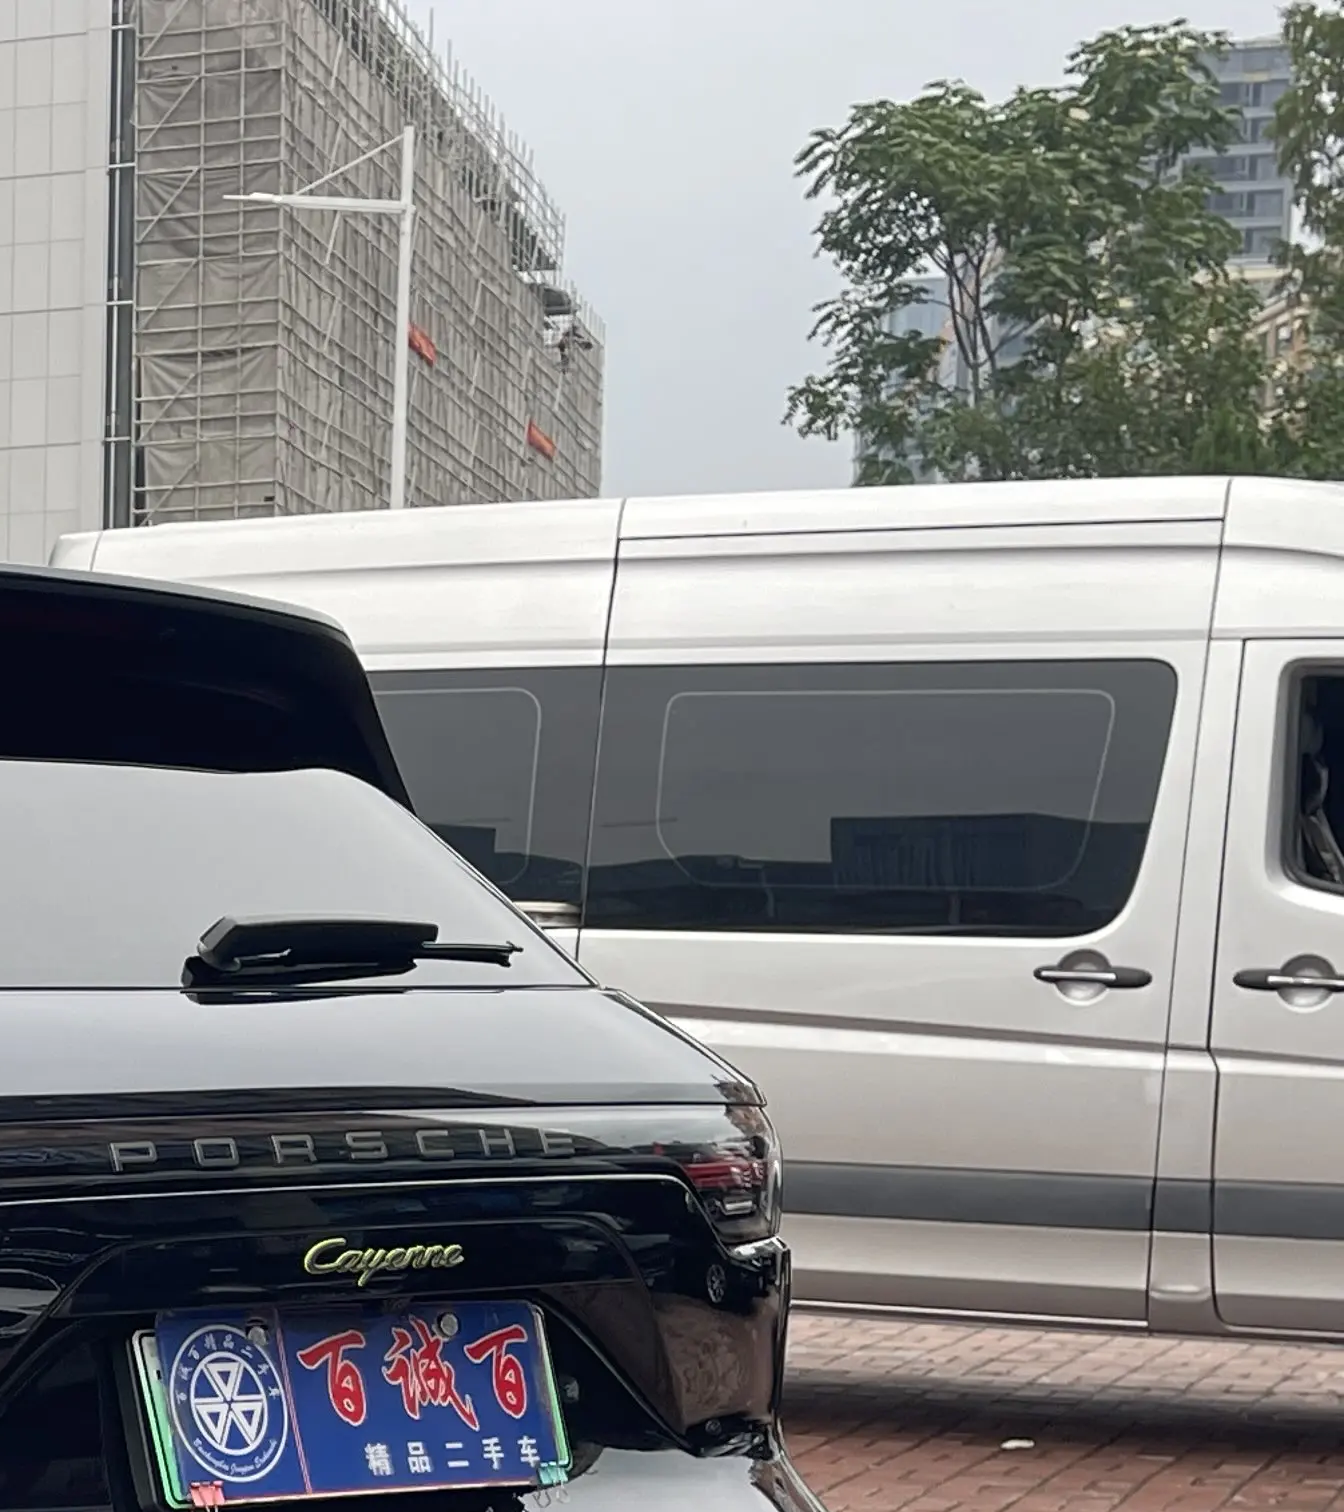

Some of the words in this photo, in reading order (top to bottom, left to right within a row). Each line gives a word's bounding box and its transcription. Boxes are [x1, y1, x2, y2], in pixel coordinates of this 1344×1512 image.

[109, 1127, 576, 1173] PORSCHE
[304, 1237, 465, 1287] Cayenne
[364, 1435, 541, 1476] 精品二手车
